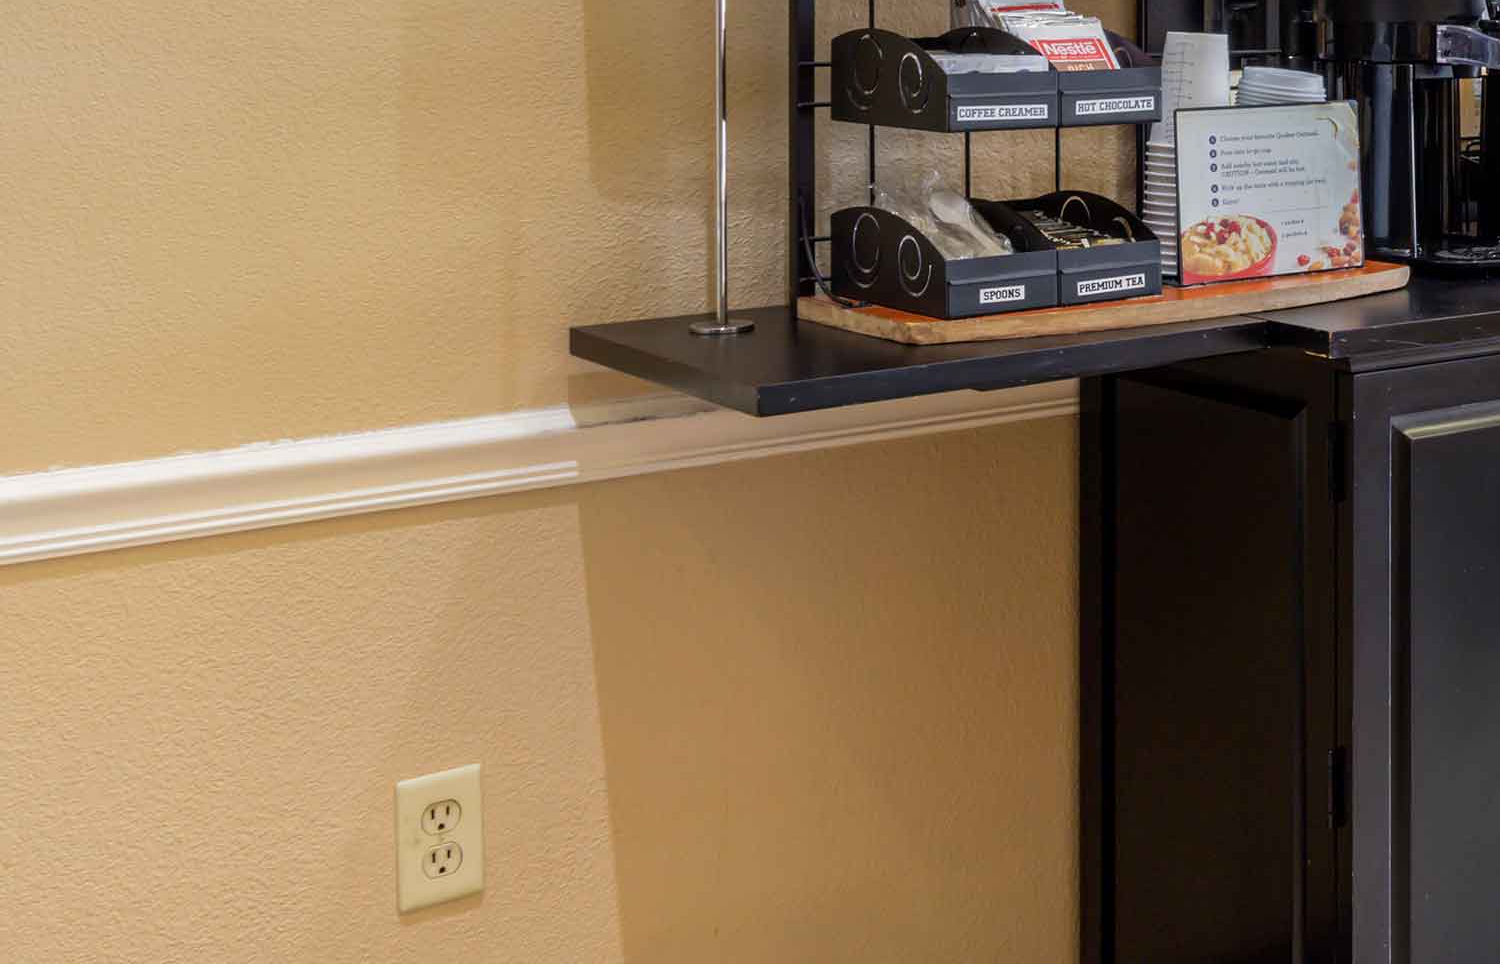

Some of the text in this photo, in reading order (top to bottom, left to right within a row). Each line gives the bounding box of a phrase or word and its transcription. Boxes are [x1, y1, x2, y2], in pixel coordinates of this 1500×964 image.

[958, 105, 1046, 118] COFFEE CREAMER
[1077, 98, 1154, 113] HOT CHOCOLATE
[1079, 275, 1145, 294] PREMIUM TEA
[983, 288, 1022, 301] SPOONS
